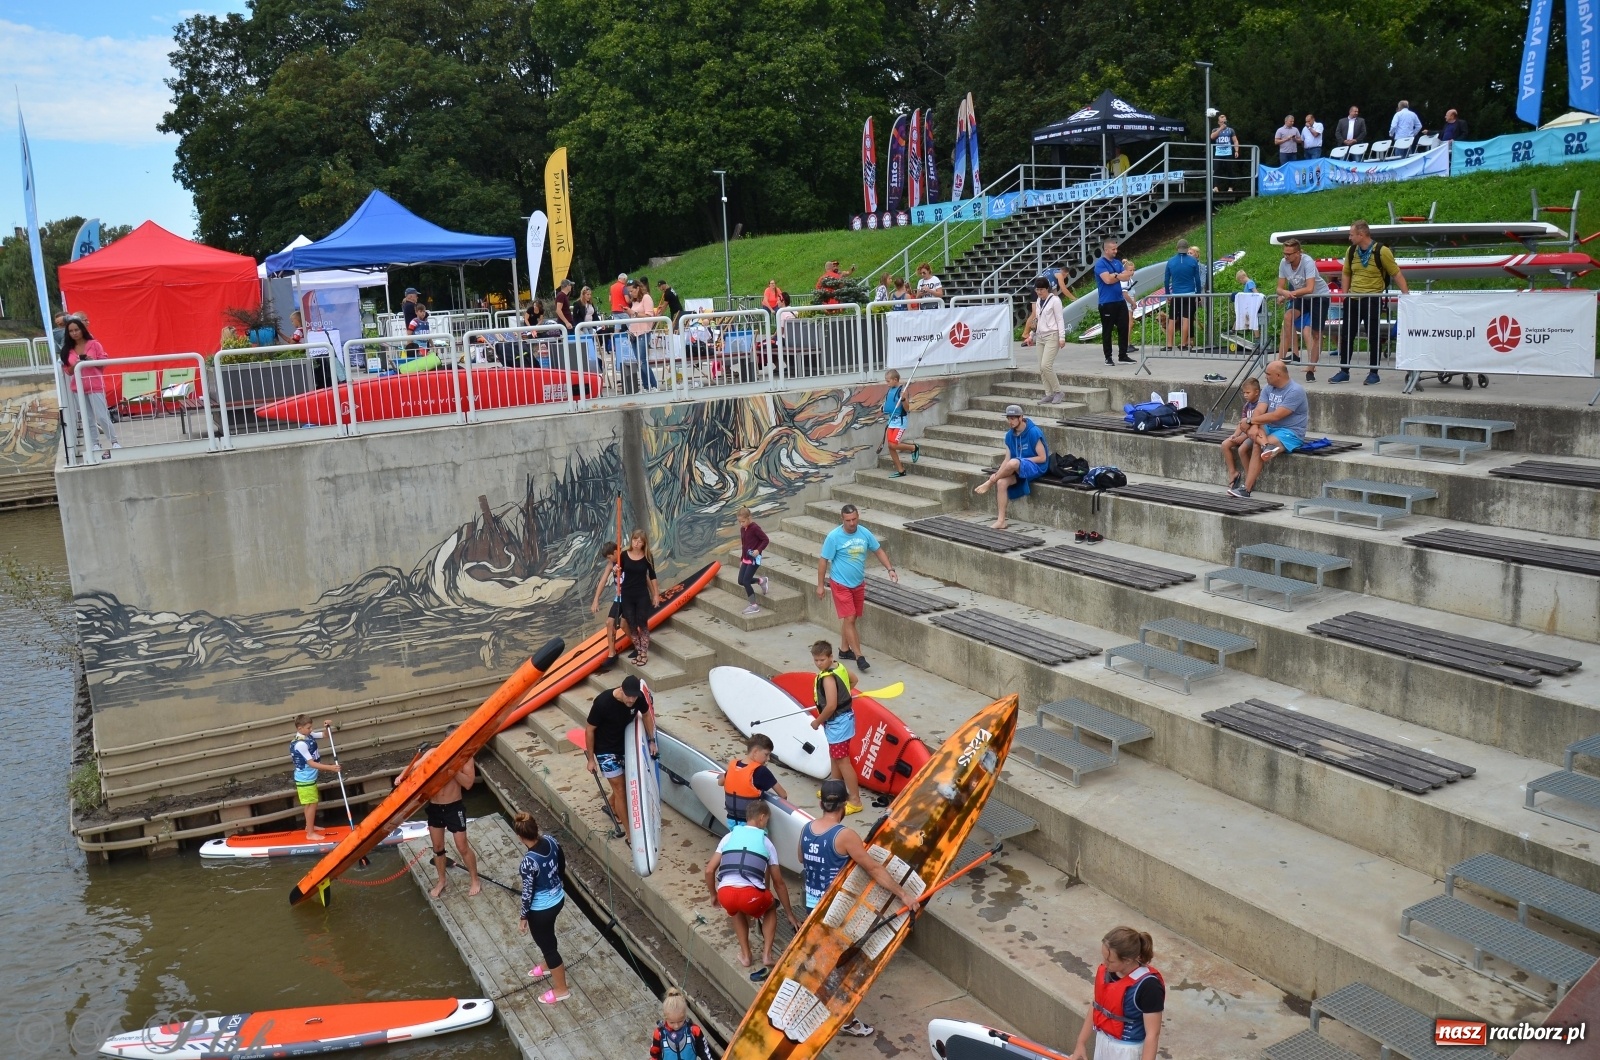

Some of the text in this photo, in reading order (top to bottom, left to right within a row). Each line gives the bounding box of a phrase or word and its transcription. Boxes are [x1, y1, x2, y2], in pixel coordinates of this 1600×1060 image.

[306, 320, 333, 328] bregion
[895, 332, 943, 343] www.zwsup.pl
[972, 333, 986, 341] SUP
[1407, 327, 1476, 340] www.zwsup.pl
[1525, 334, 1550, 344] SUP
[861, 721, 887, 780] SHARK
[630, 779, 641, 830] STARBOARD
[808, 843, 820, 854] 35
